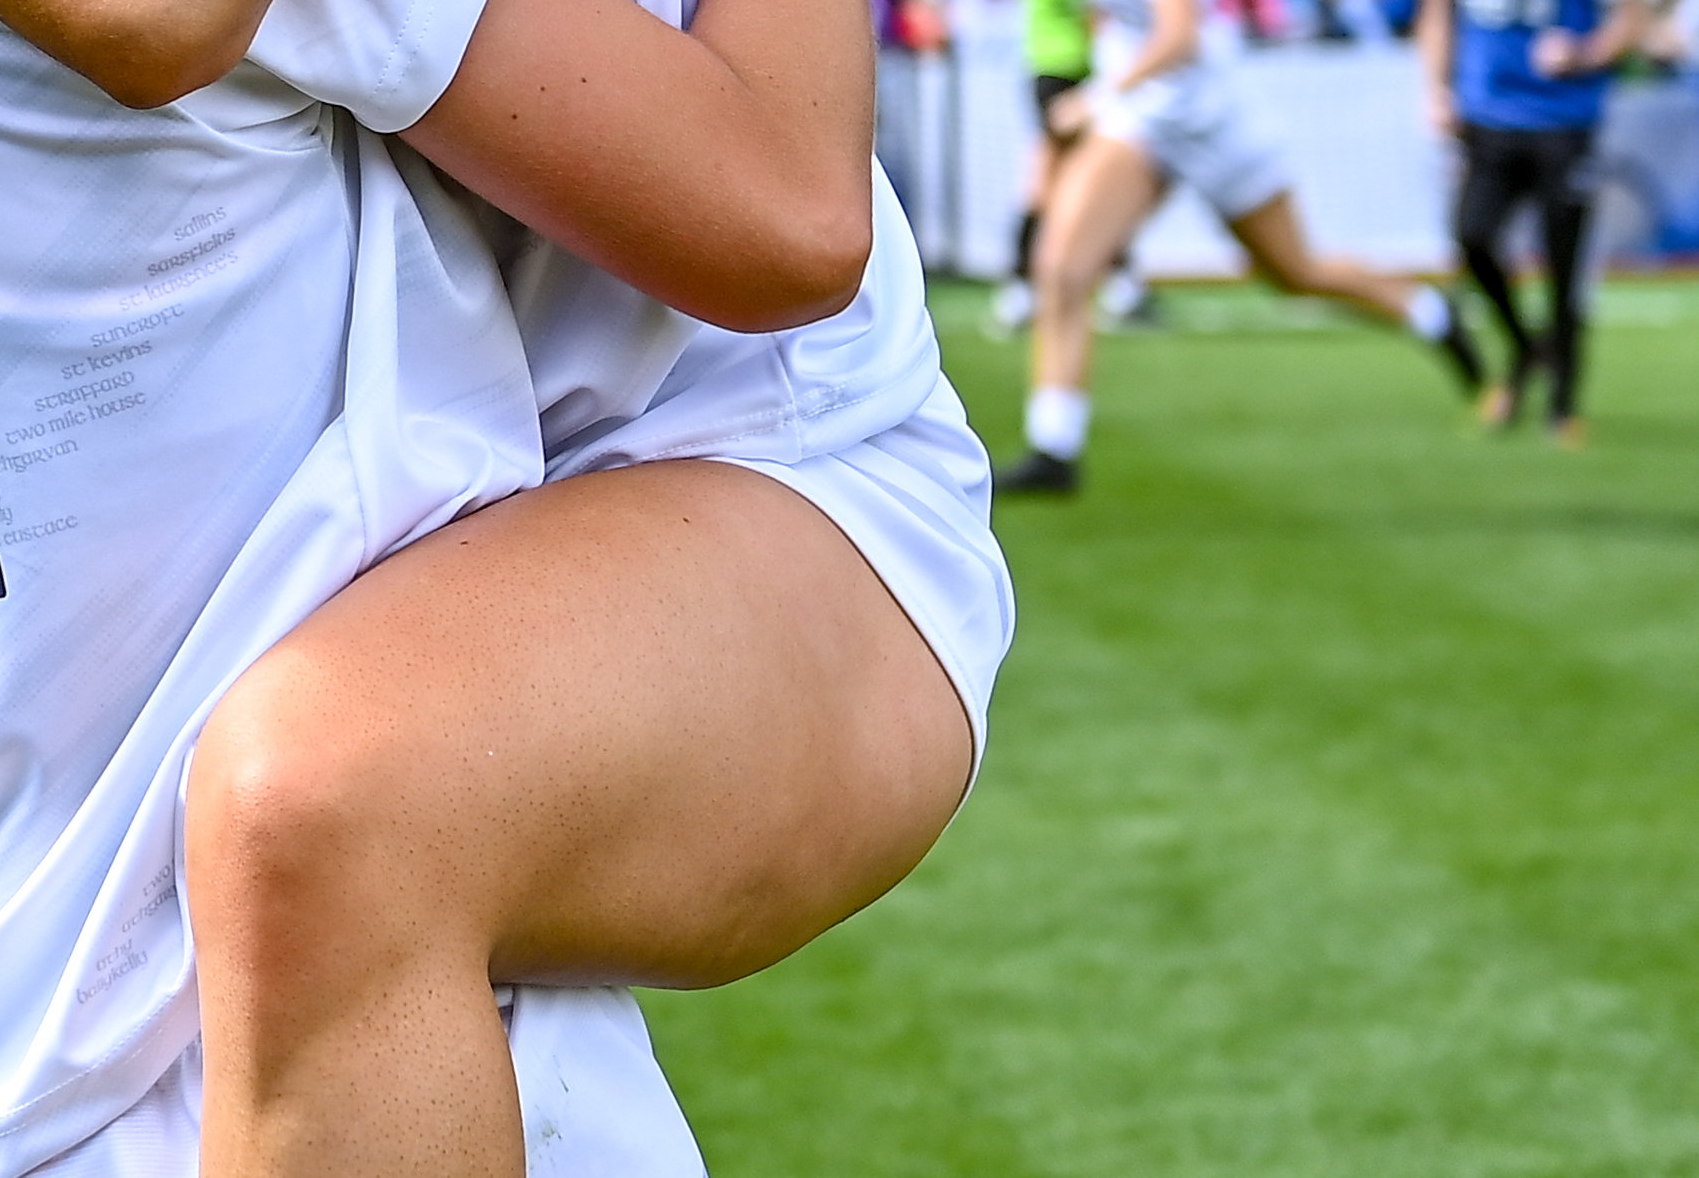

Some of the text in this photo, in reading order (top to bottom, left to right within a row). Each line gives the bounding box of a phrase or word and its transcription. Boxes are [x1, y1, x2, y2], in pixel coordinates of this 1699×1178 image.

[174, 207, 226, 242] sallins
[147, 228, 236, 277] sarsfields
[91, 303, 184, 348] suncroft
[61, 338, 152, 380] st kevins
[6, 390, 147, 446] two mile house
